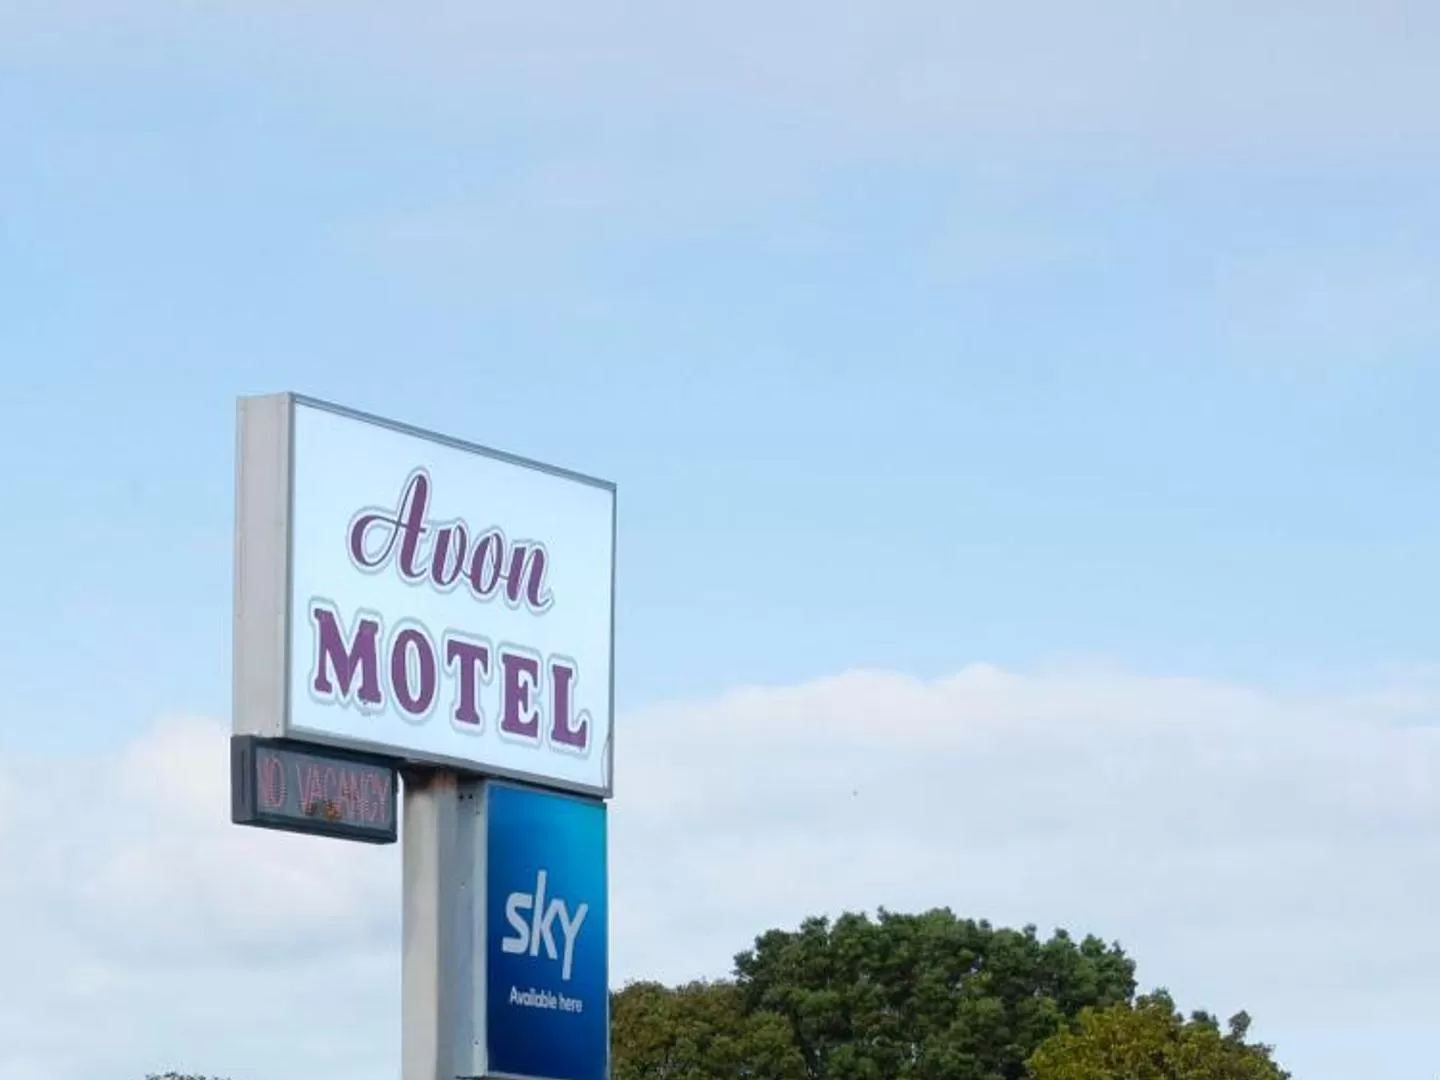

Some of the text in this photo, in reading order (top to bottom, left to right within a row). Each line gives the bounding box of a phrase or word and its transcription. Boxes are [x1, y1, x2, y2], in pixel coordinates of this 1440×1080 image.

[350, 472, 553, 608] Avon
[313, 606, 588, 748] MOTEL
[295, 763, 391, 823] VACANCY
[501, 869, 589, 981] sky
[510, 985, 583, 1013] Available here
